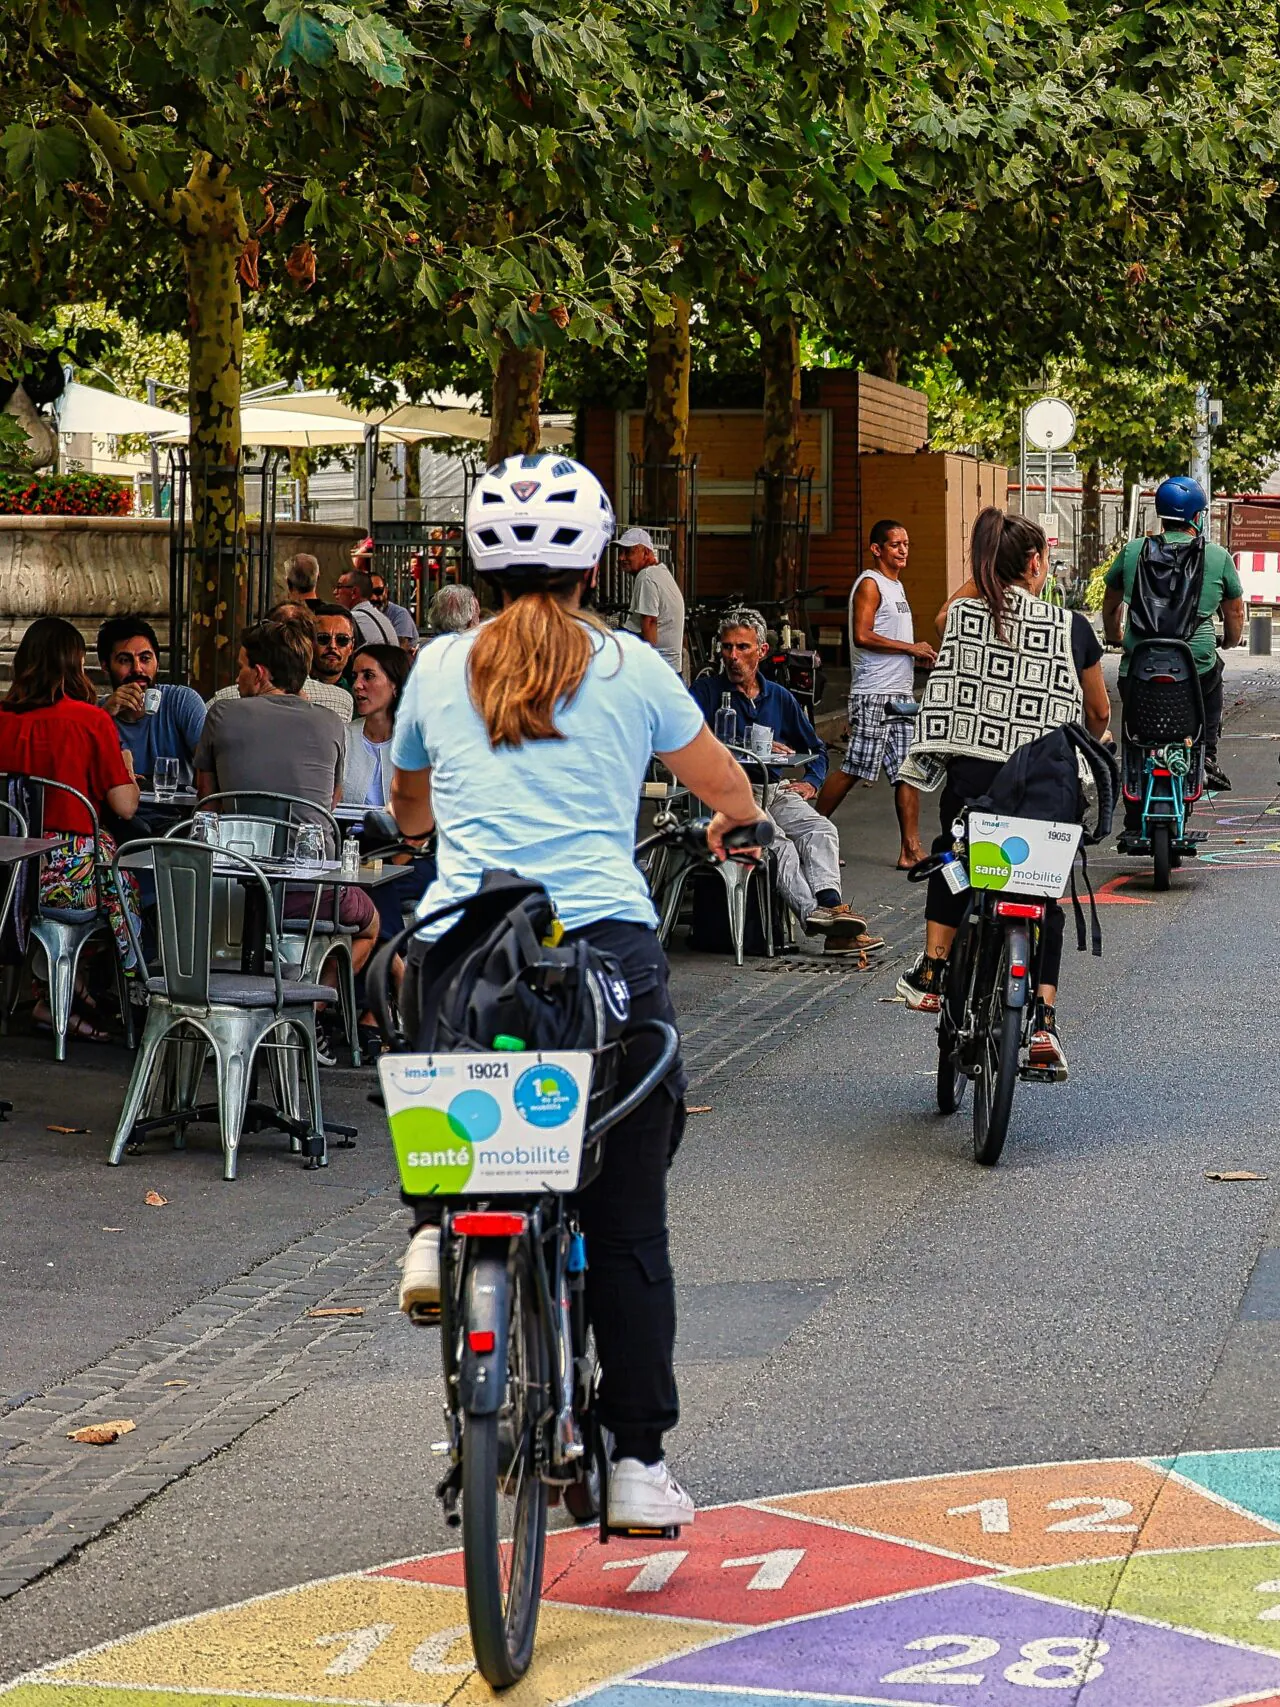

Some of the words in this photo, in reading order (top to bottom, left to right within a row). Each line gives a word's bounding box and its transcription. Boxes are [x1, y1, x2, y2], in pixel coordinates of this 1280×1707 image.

[1047, 830, 1072, 842] 19053
[975, 864, 1008, 877] santé
[1013, 870, 1062, 884] mobilité
[467, 1063, 510, 1079] 19021
[407, 1146, 470, 1167] santé
[479, 1146, 570, 1165] mobilité
[946, 1496, 1139, 1535] 12
[603, 1548, 807, 1592] 11
[879, 1636, 1111, 1690] 28
